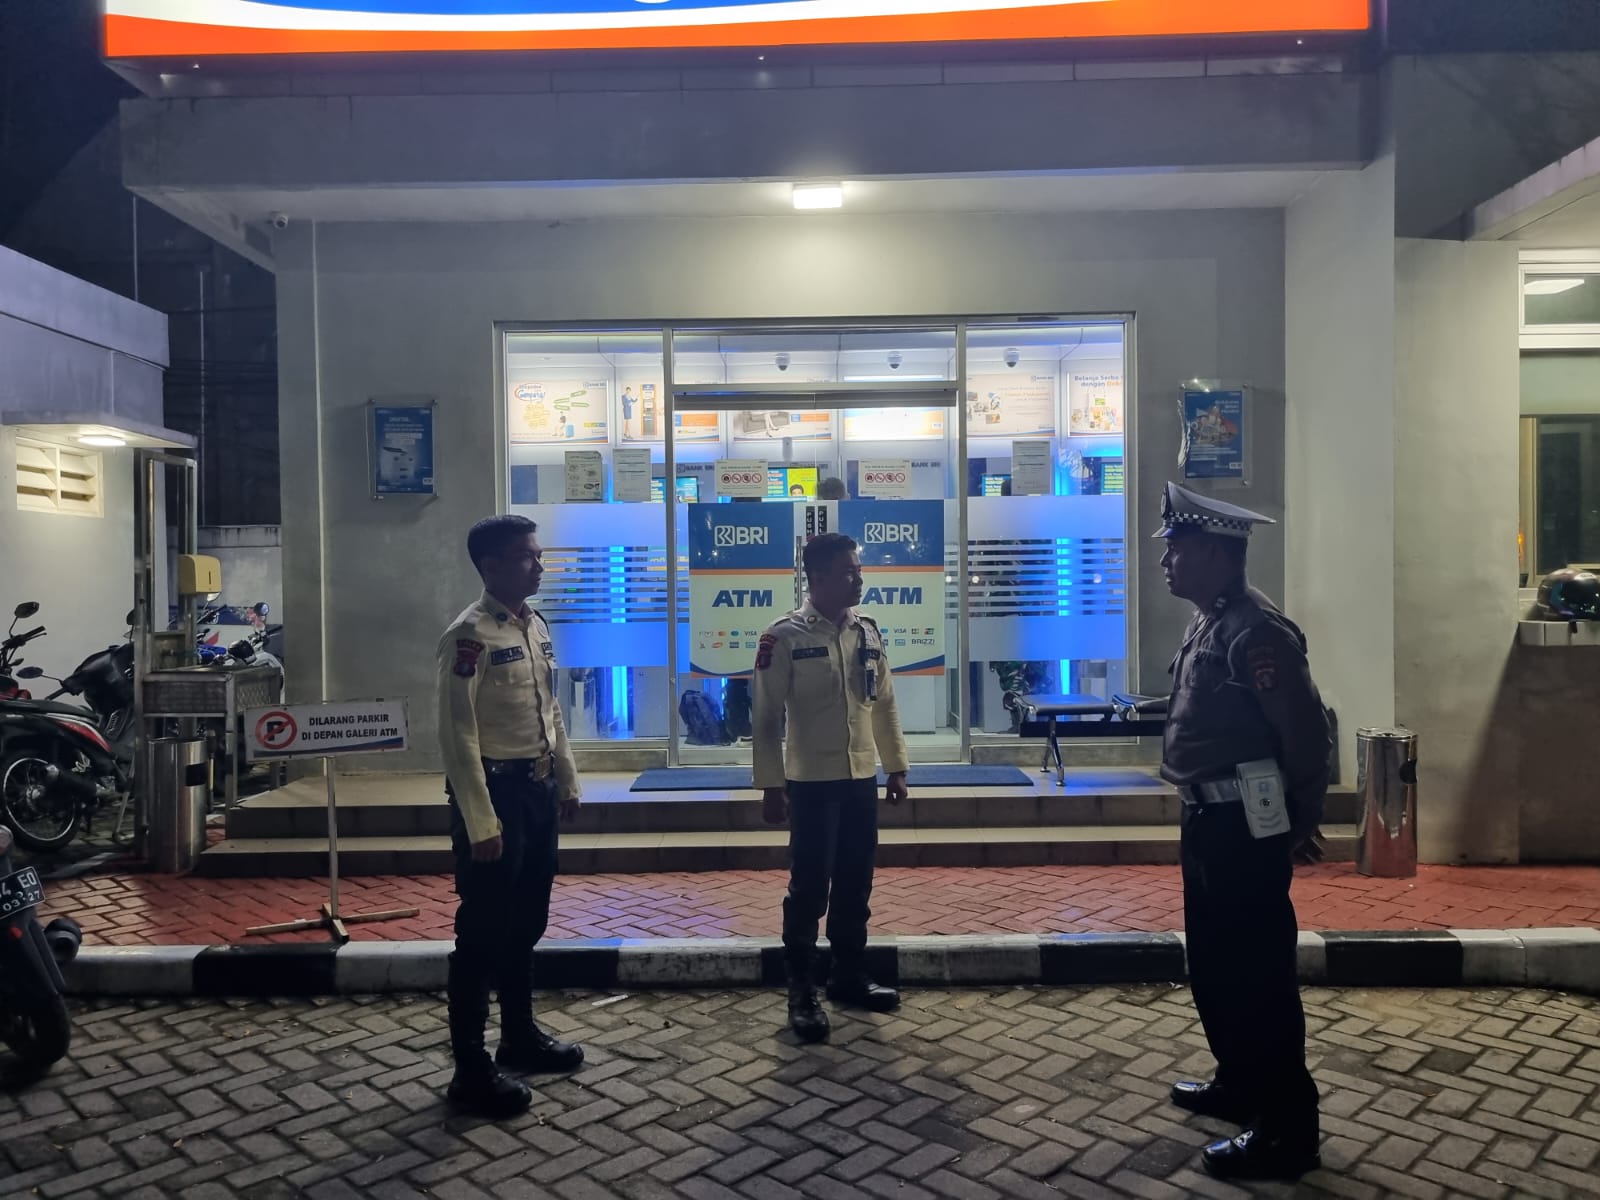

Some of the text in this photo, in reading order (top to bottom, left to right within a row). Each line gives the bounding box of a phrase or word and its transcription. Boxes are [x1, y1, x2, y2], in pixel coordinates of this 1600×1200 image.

[736, 526, 769, 545] BRI
[885, 523, 919, 543] BRI
[711, 589, 773, 608] ATM
[861, 587, 922, 605] ATM
[309, 713, 389, 726] DILARANG PARKIR
[301, 727, 398, 741] DI DEPAN GALERI ATM
